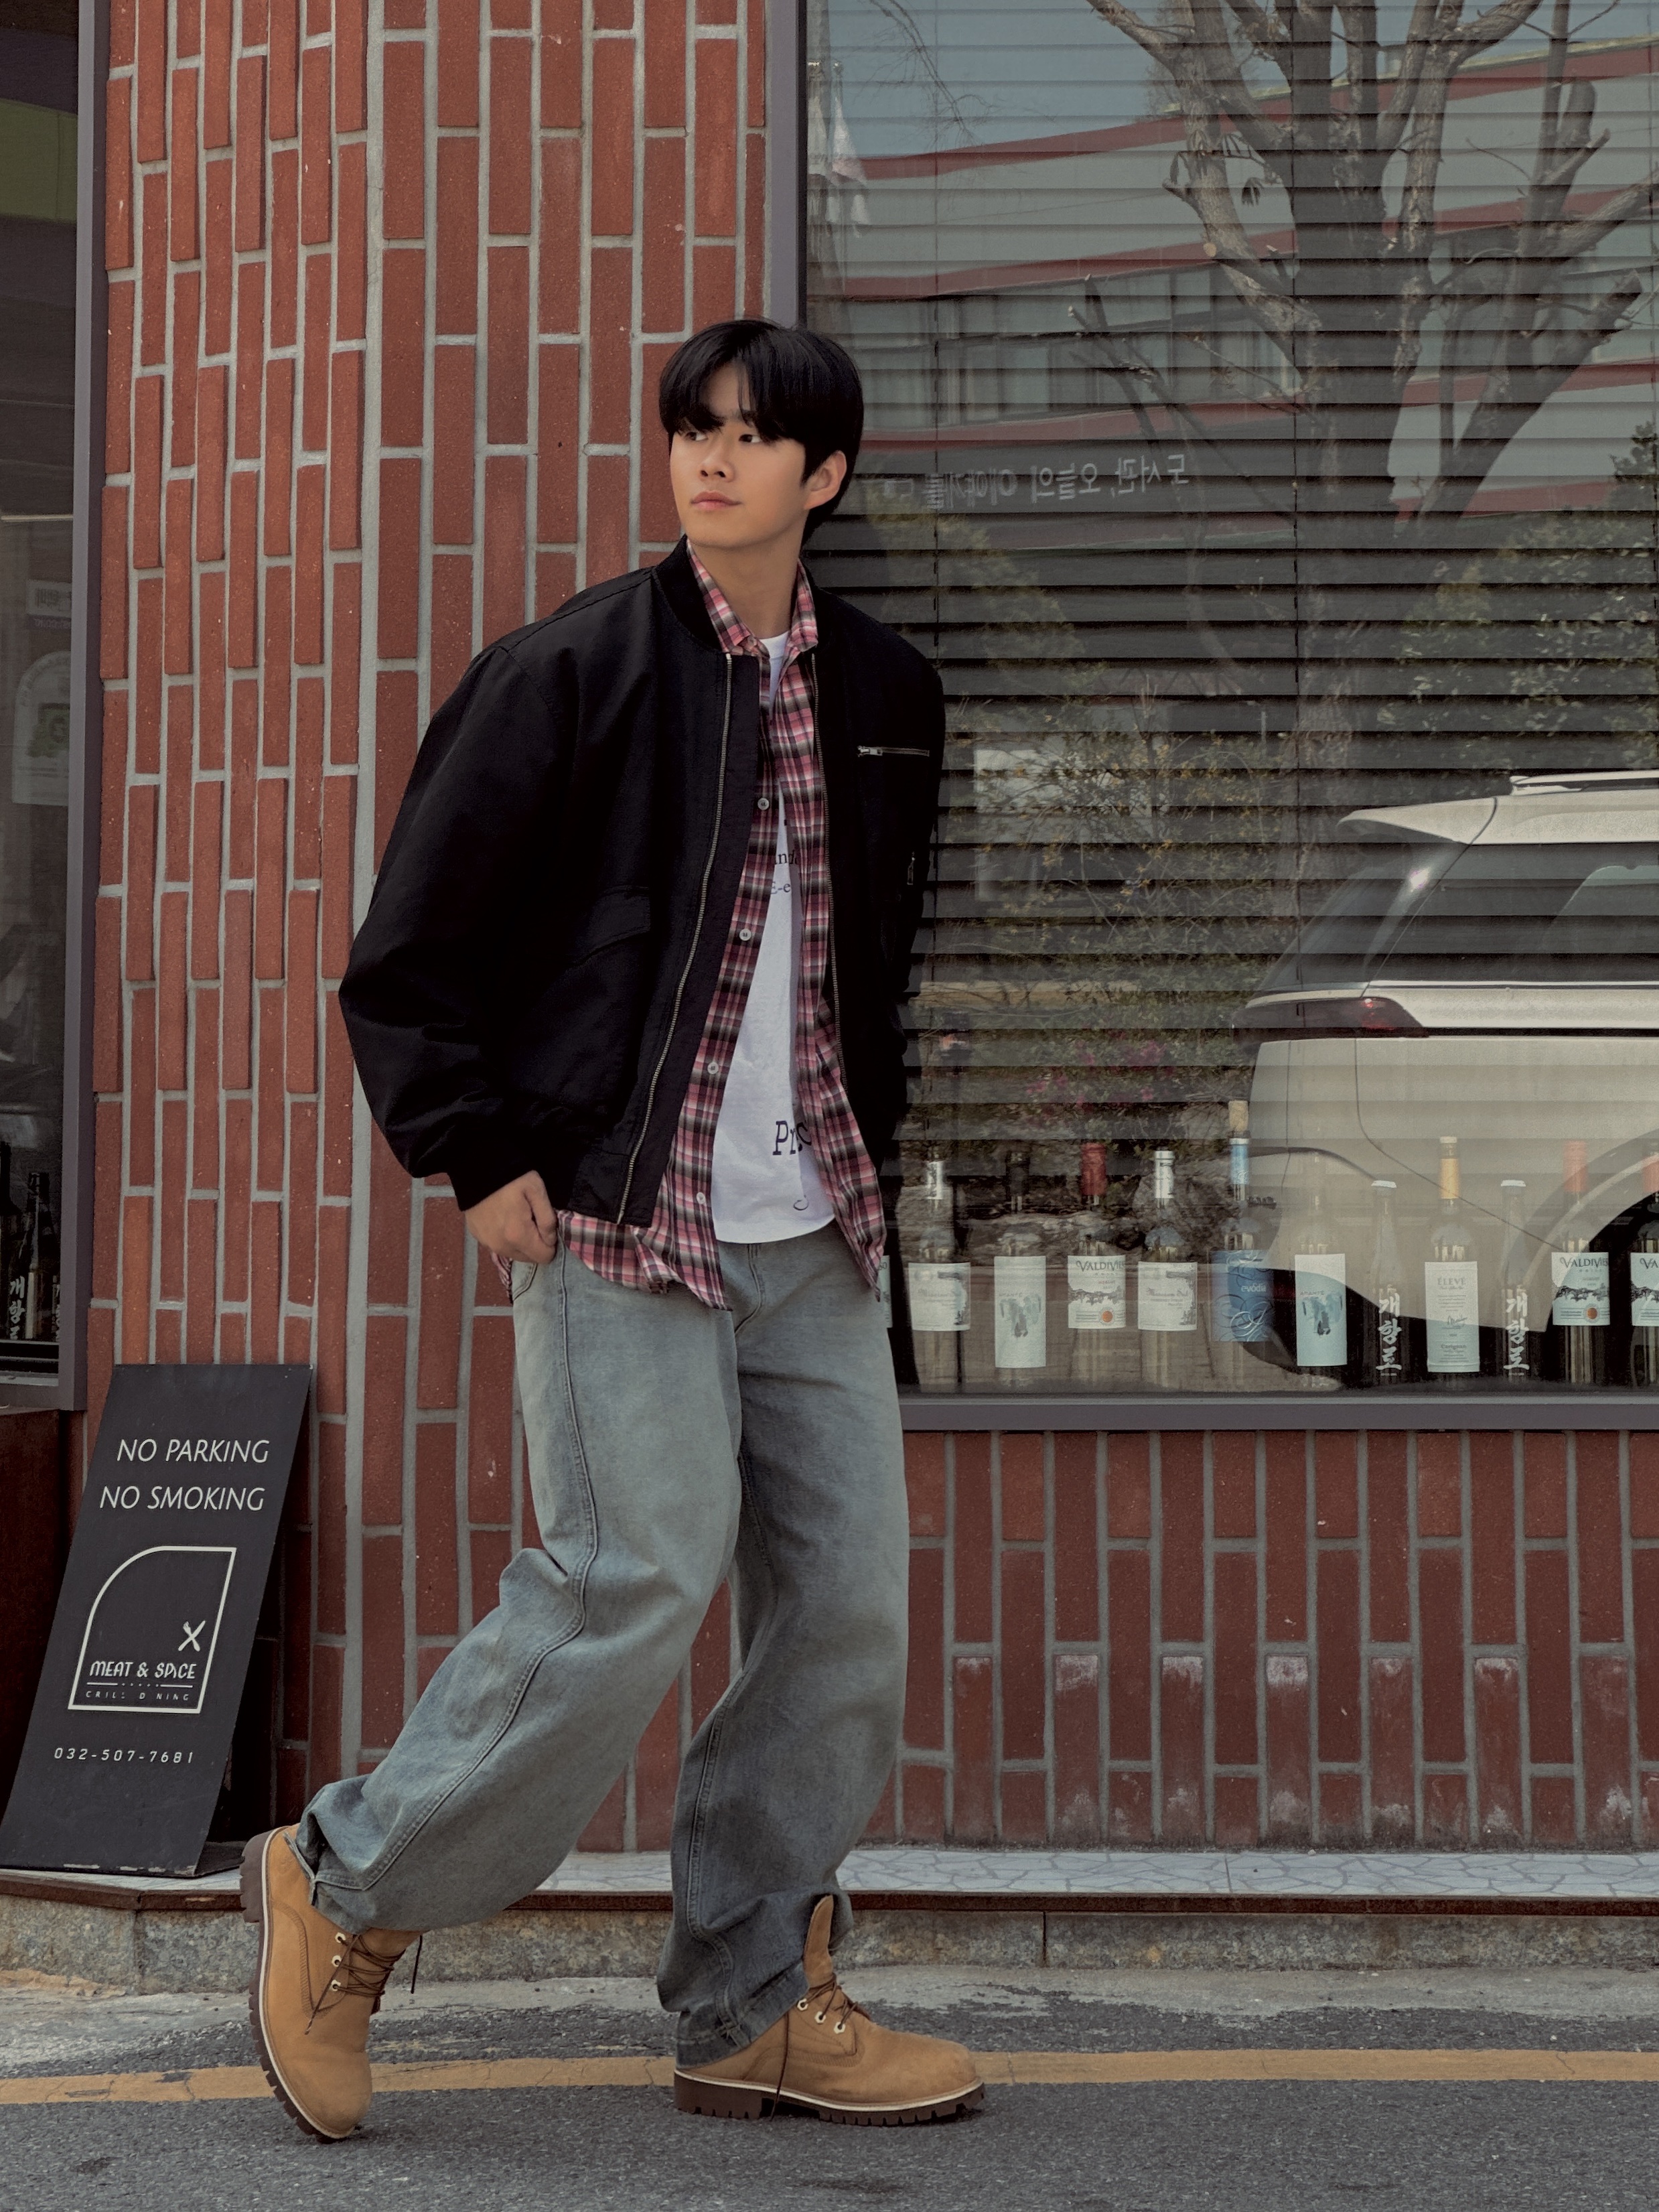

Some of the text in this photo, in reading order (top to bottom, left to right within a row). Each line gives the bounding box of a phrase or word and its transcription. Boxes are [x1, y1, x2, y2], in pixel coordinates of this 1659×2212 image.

[1376, 1292, 1402, 1371] 개항로
[1503, 1292, 1530, 1371] 개항로
[116, 1438, 271, 1464] NO PARKING
[99, 1485, 266, 1512] NO SMOKING
[89, 1661, 198, 1679] MEAT & SPICE
[53, 1747, 194, 1764] 032-507-7681
